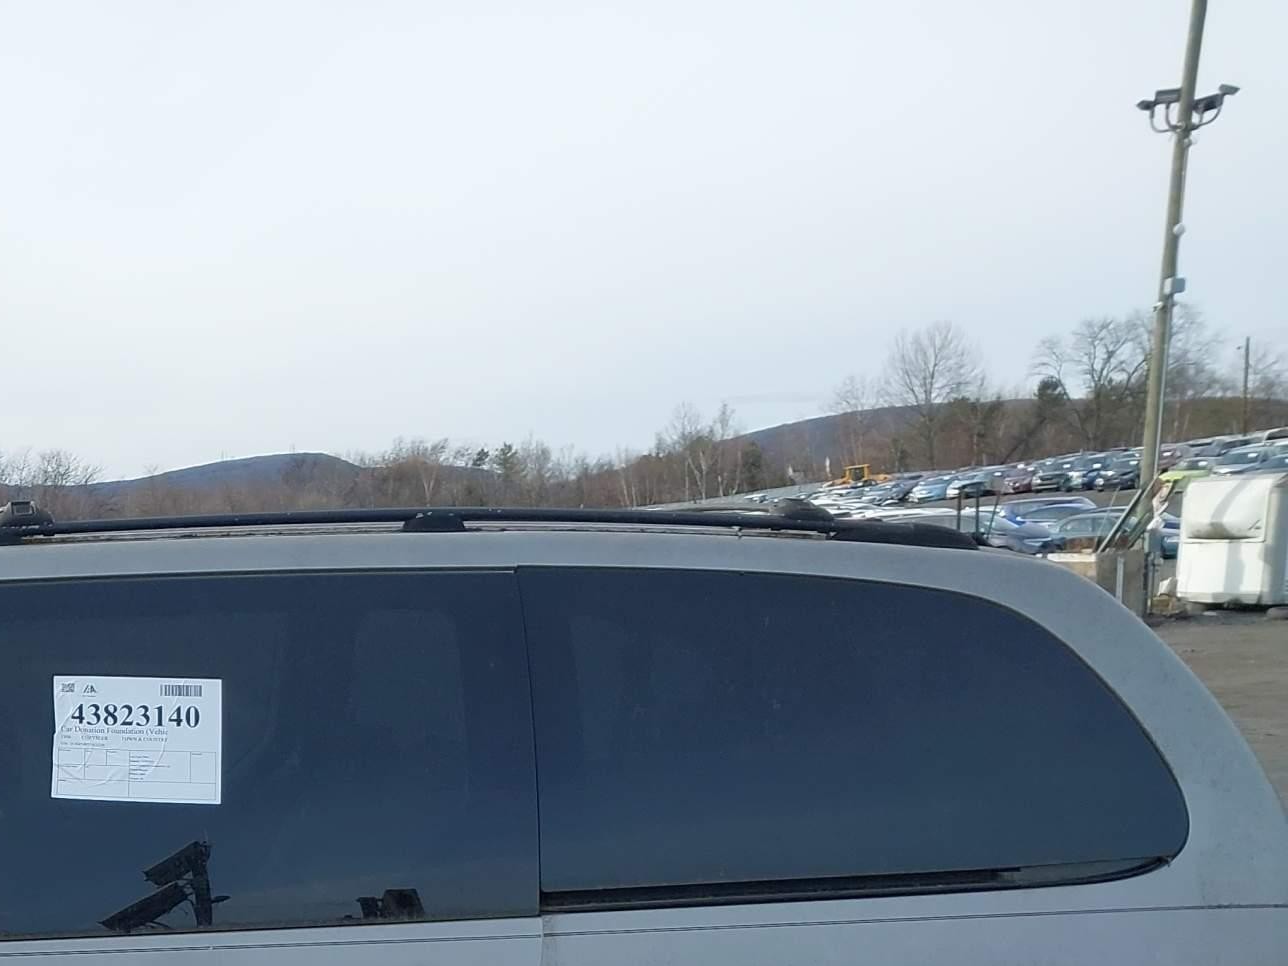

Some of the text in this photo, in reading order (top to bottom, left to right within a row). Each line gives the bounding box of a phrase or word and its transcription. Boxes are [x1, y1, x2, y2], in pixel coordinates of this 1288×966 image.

[71, 703, 201, 728] 43823140
[74, 726, 105, 734] Donation
[107, 727, 144, 735] Foundation
